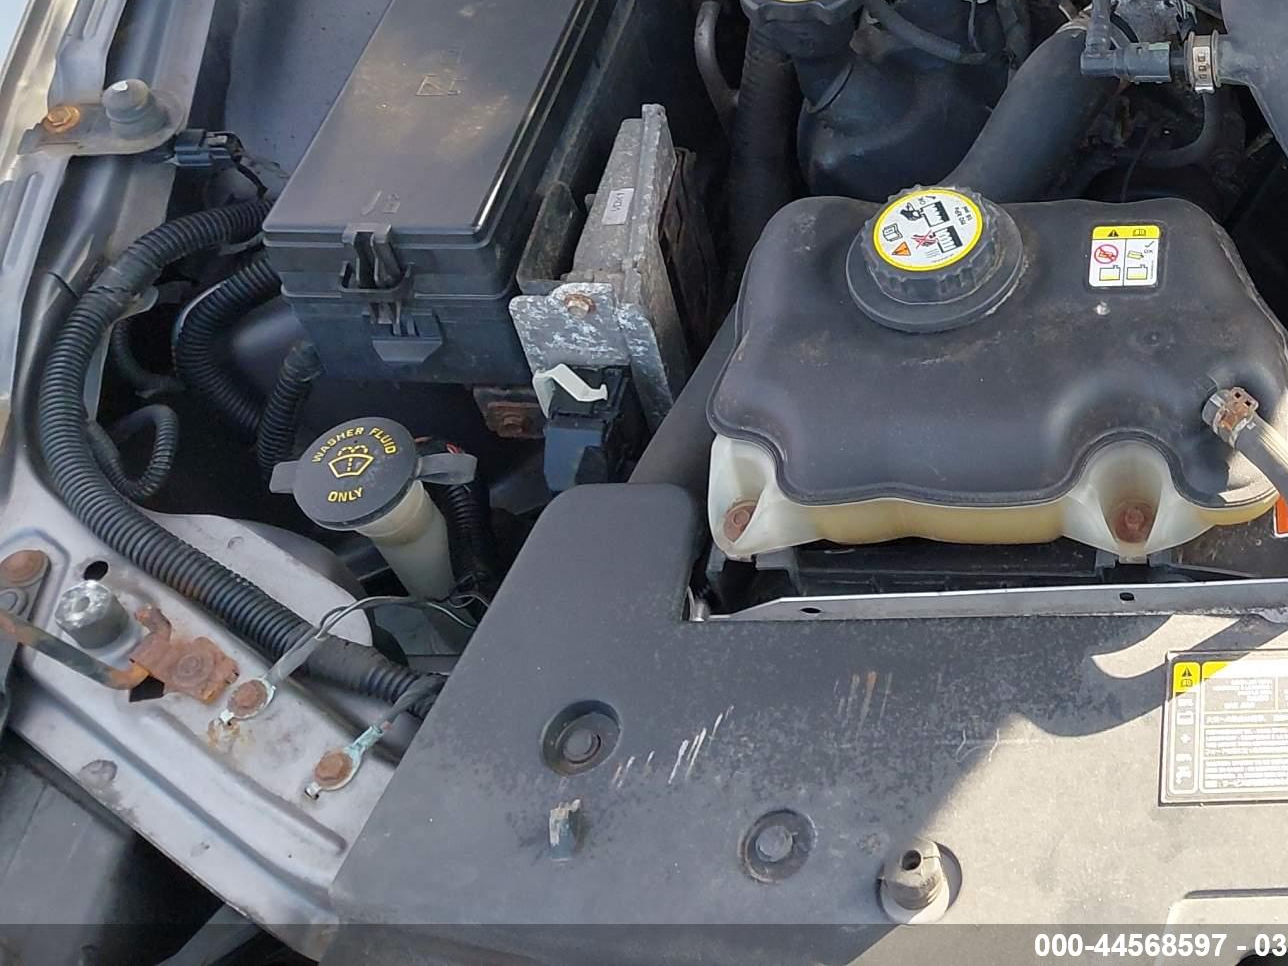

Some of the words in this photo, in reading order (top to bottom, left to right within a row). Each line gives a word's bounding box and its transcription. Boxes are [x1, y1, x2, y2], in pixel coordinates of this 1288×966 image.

[312, 427, 364, 462] WASHER
[369, 427, 397, 455] FLUID
[327, 487, 364, 503] ONLY
